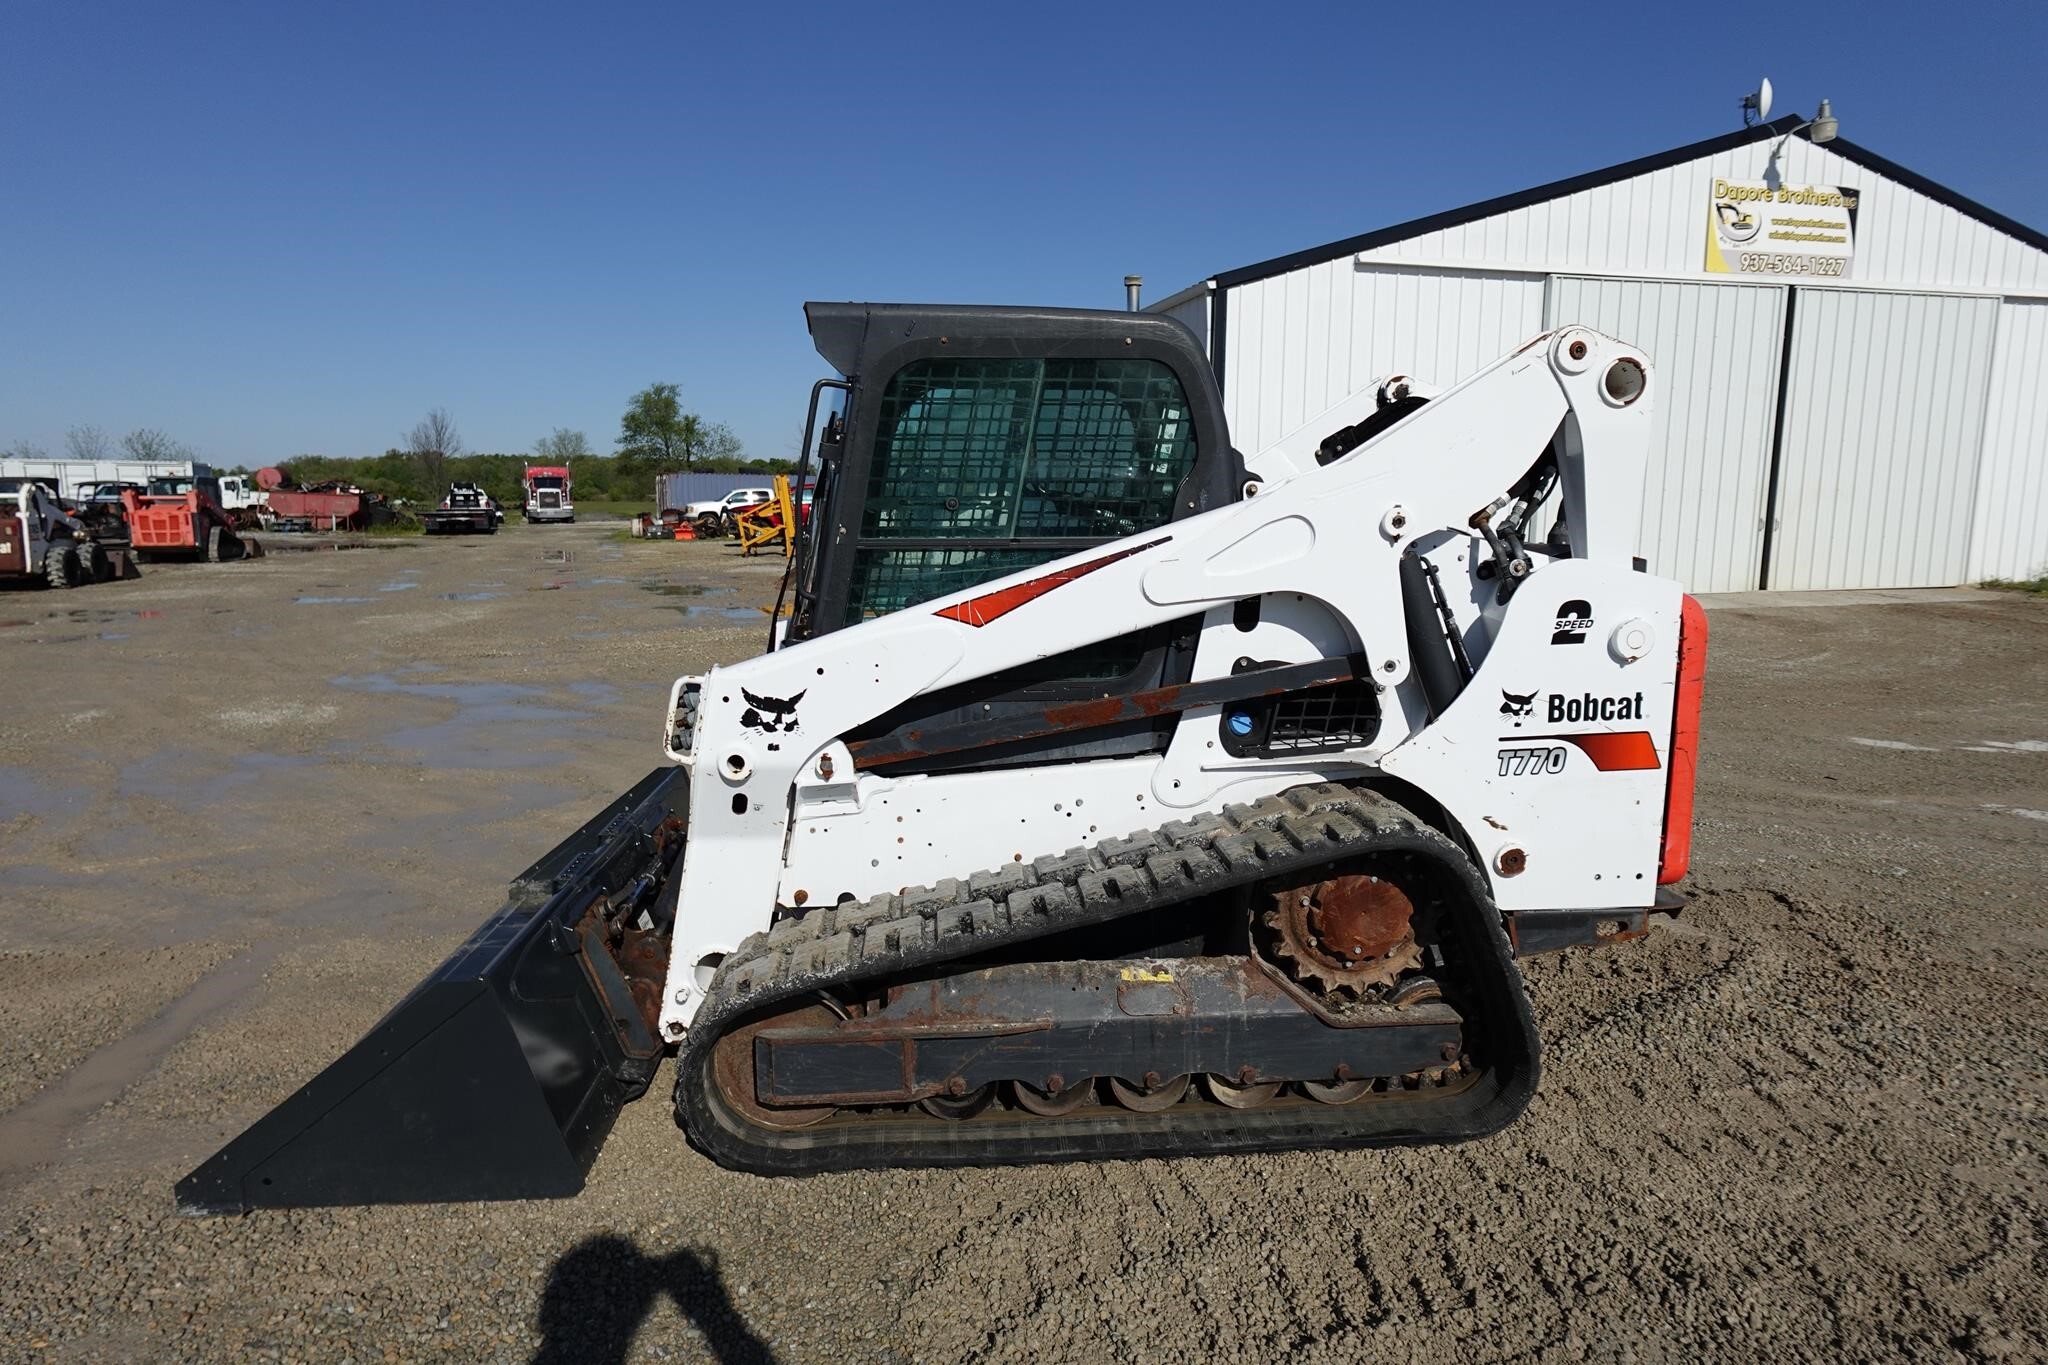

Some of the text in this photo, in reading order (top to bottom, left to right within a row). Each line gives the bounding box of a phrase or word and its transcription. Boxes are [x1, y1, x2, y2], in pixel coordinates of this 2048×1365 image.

[1714, 180, 1773, 205] Dapore
[1778, 185, 1842, 207] Brothers
[1740, 253, 1846, 276] 937-564-1227
[1551, 599, 1592, 645] 2
[1554, 619, 1594, 630] SPEED
[1548, 692, 1643, 723] Bobcat
[1497, 746, 1568, 777] T770
